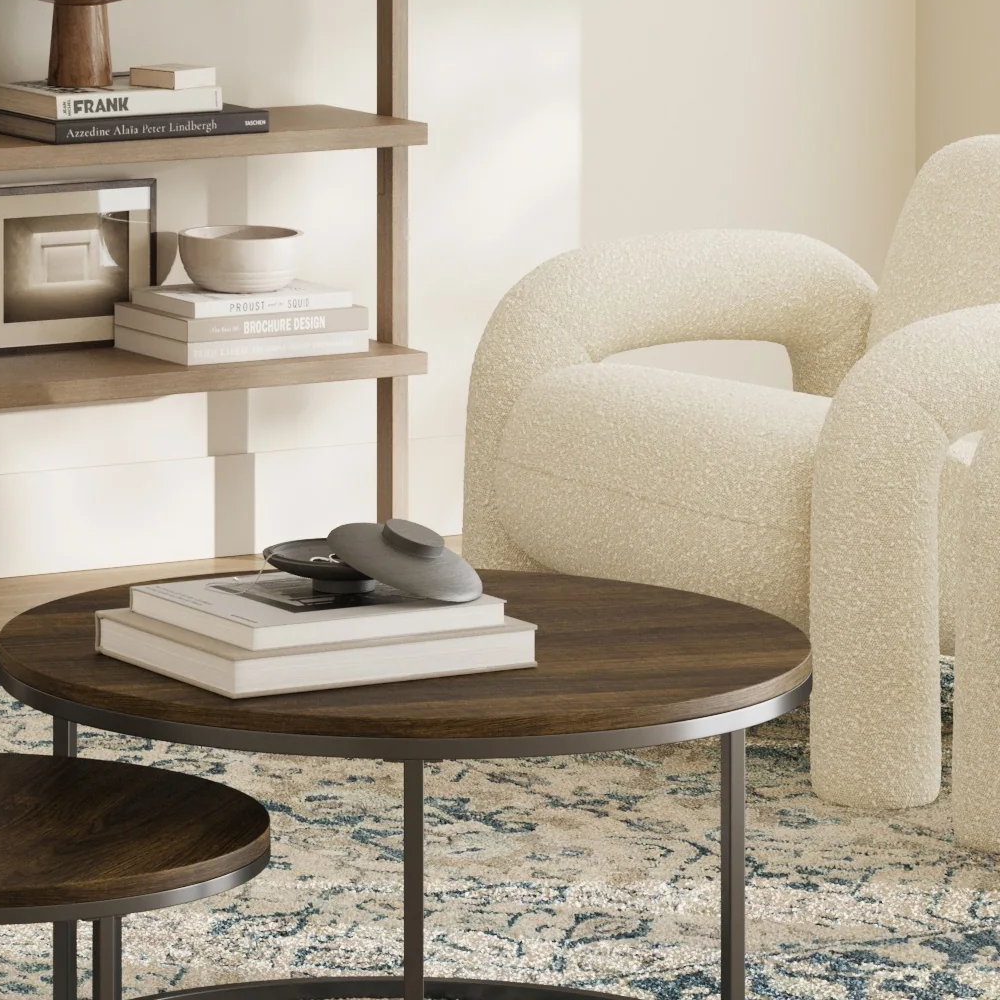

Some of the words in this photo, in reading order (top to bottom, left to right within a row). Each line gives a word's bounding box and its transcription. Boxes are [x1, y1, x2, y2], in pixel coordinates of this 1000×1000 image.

[73, 97, 129, 114] FRANK
[66, 126, 110, 138] Azzedine
[113, 124, 139, 137] Alaïa
[142, 122, 166, 134] Peter
[169, 119, 218, 133] Lindbergh
[229, 301, 265, 313] PROUST
[287, 297, 310, 309] SQUID
[243, 319, 292, 335] BROCHURE
[293, 315, 326, 331] DESIGN
